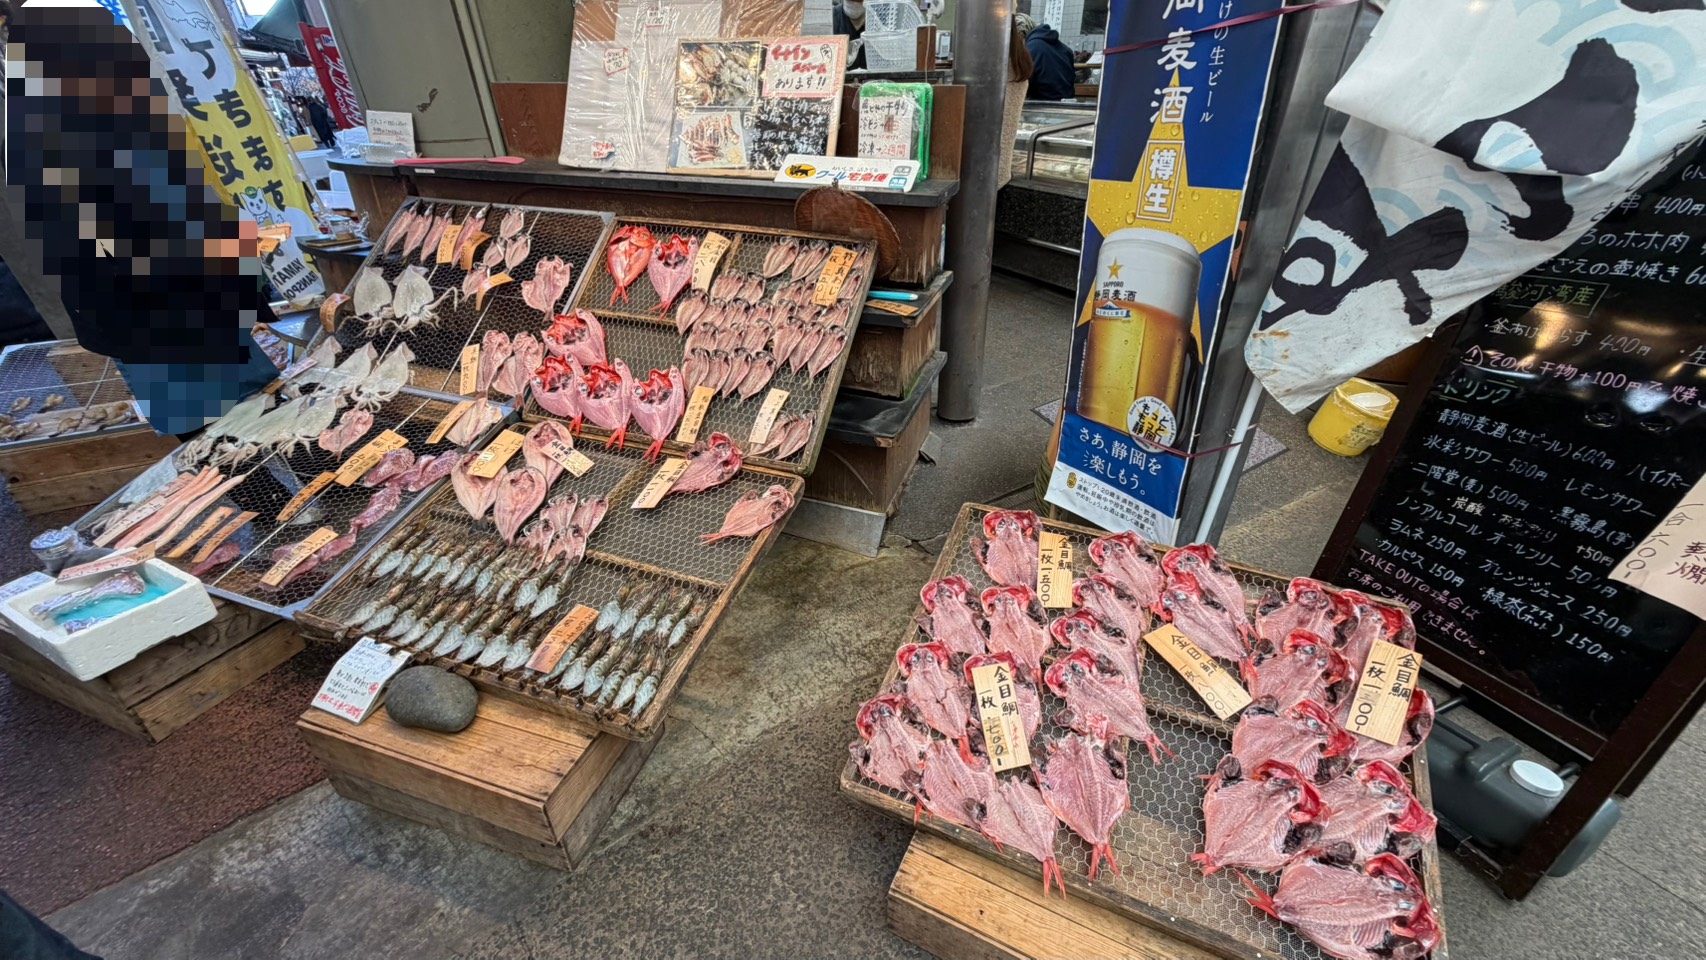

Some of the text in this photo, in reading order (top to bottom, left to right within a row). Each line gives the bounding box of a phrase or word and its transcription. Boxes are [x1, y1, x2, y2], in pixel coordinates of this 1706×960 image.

[815, 170, 889, 182] クール宅急便
[1143, 149, 1177, 214] 樽生
[1654, 196, 1706, 216] 400円
[1103, 280, 1125, 288] SAPPORO
[1494, 279, 1596, 306] 駿河湾産
[1443, 377, 1512, 404] ドリンク
[1138, 412, 1165, 438] もっと
[1142, 403, 1169, 429] もっと
[1079, 426, 1162, 476] さあ、静岡を
[1089, 453, 1146, 496] 楽しもう。
[1508, 457, 1549, 482] 500円
[1565, 477, 1657, 517] レモンサワー
[1487, 485, 1531, 511] 500円
[1389, 516, 1468, 560] ラムネ 250円
[1396, 496, 1483, 536] ノンアルコール
[1486, 531, 1562, 570] オールフリー
[1451, 496, 1488, 517] 炭酸
[1576, 544, 1615, 567] +50円
[1056, 537, 1073, 572] 金目鯛
[1360, 548, 1397, 575] TAKE
[1377, 539, 1466, 588] カルピス 150円
[1478, 558, 1633, 638] オレンジジュース 250円
[1170, 634, 1218, 677] 金目鯛
[1565, 632, 1614, 663] 150円
[993, 665, 1020, 716] 金目鯛
[1387, 652, 1421, 702] 金目鯛
